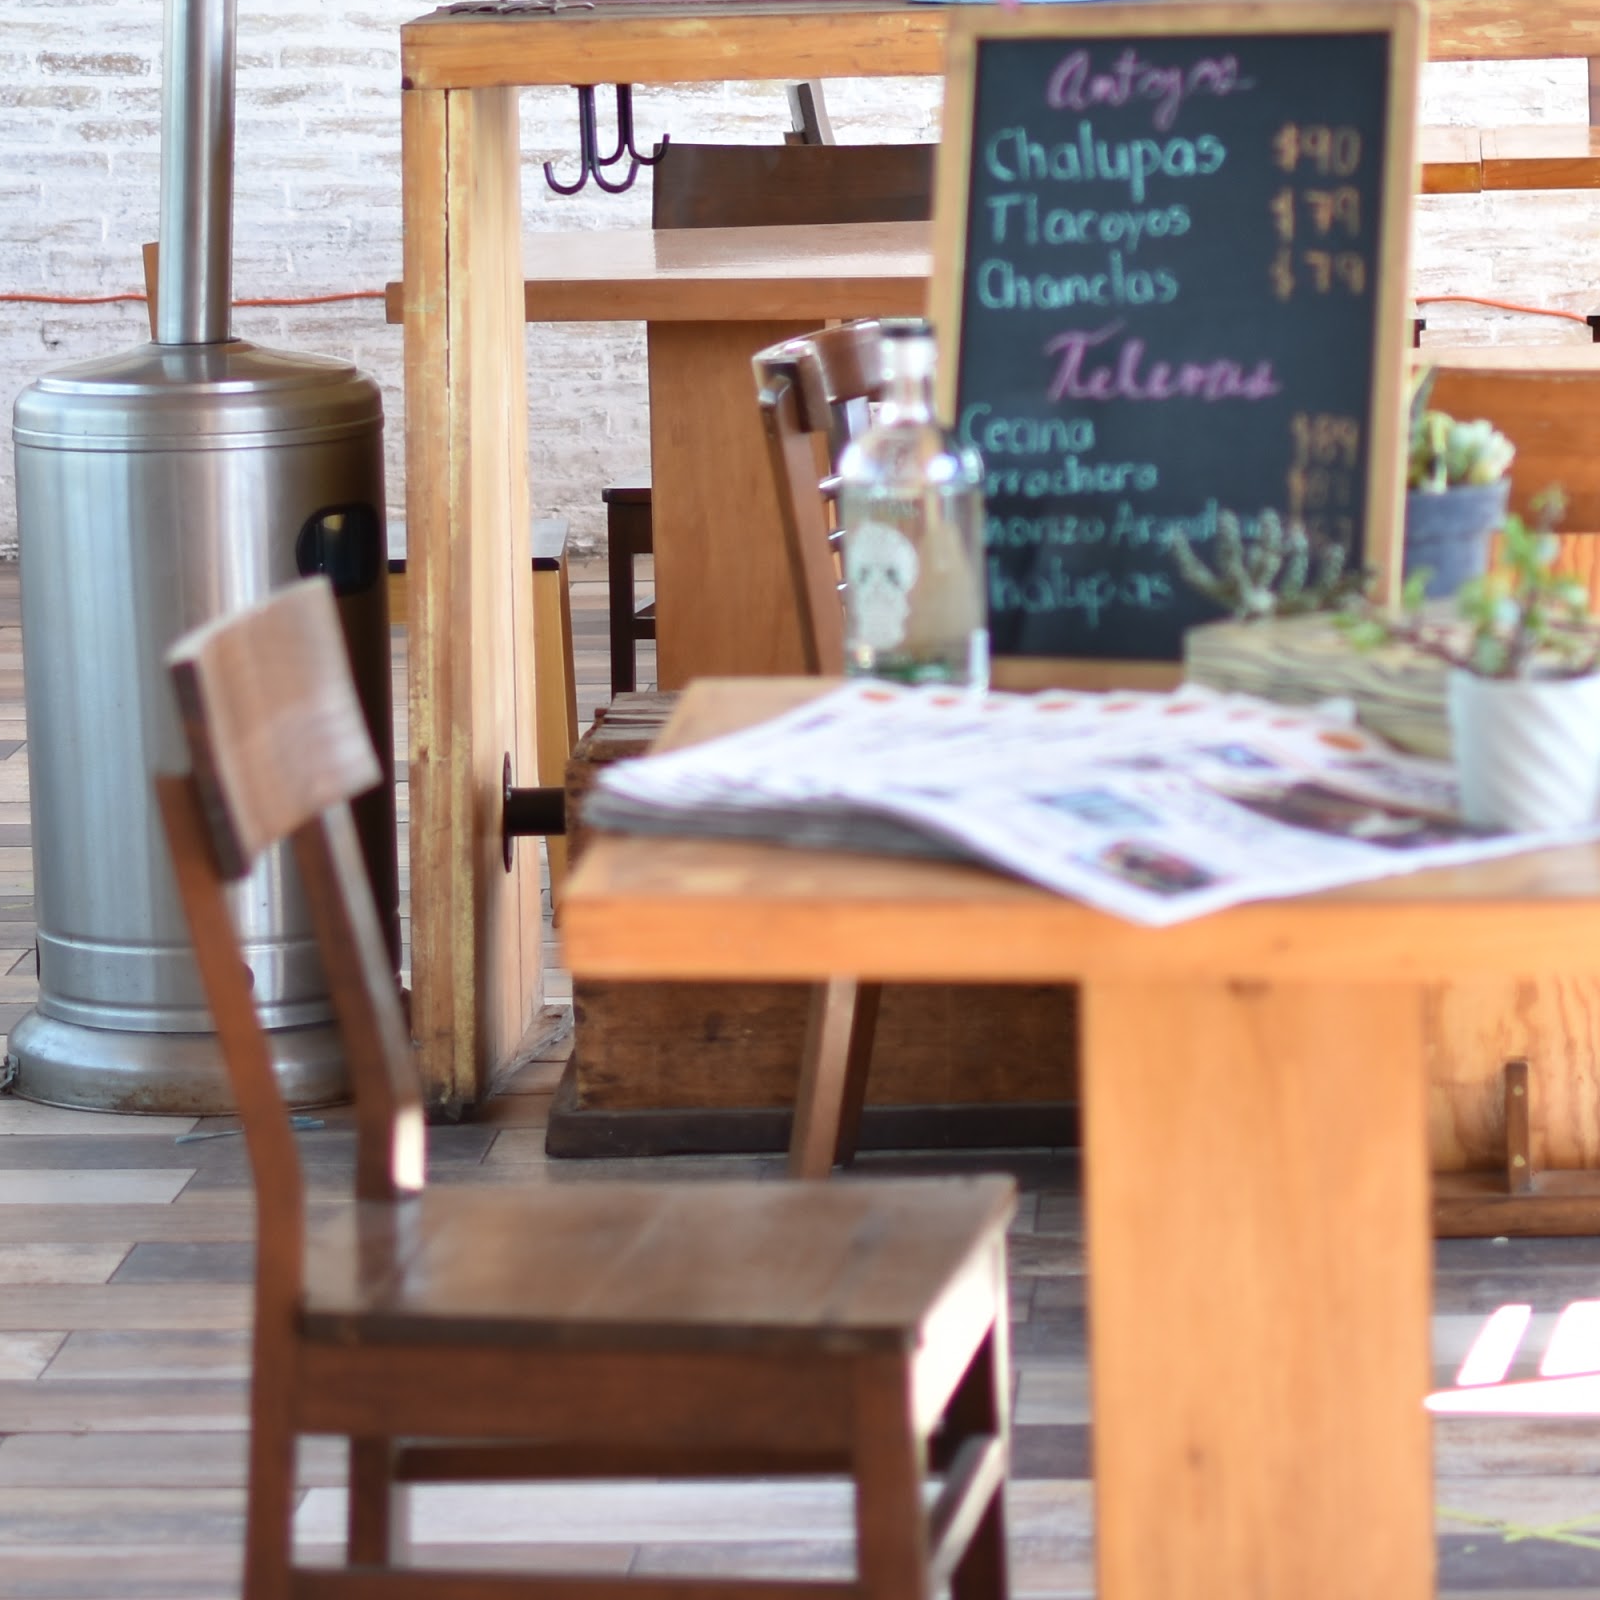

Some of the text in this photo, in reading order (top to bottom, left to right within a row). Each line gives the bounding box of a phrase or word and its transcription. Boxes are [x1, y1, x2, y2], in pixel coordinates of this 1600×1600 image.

[985, 120, 1360, 202] Chalupas $90
[987, 193, 1191, 252] Tlacoyos
[976, 249, 1179, 310] Chanclas
[985, 454, 1159, 497] rrachera
[988, 554, 1172, 628] halupas
